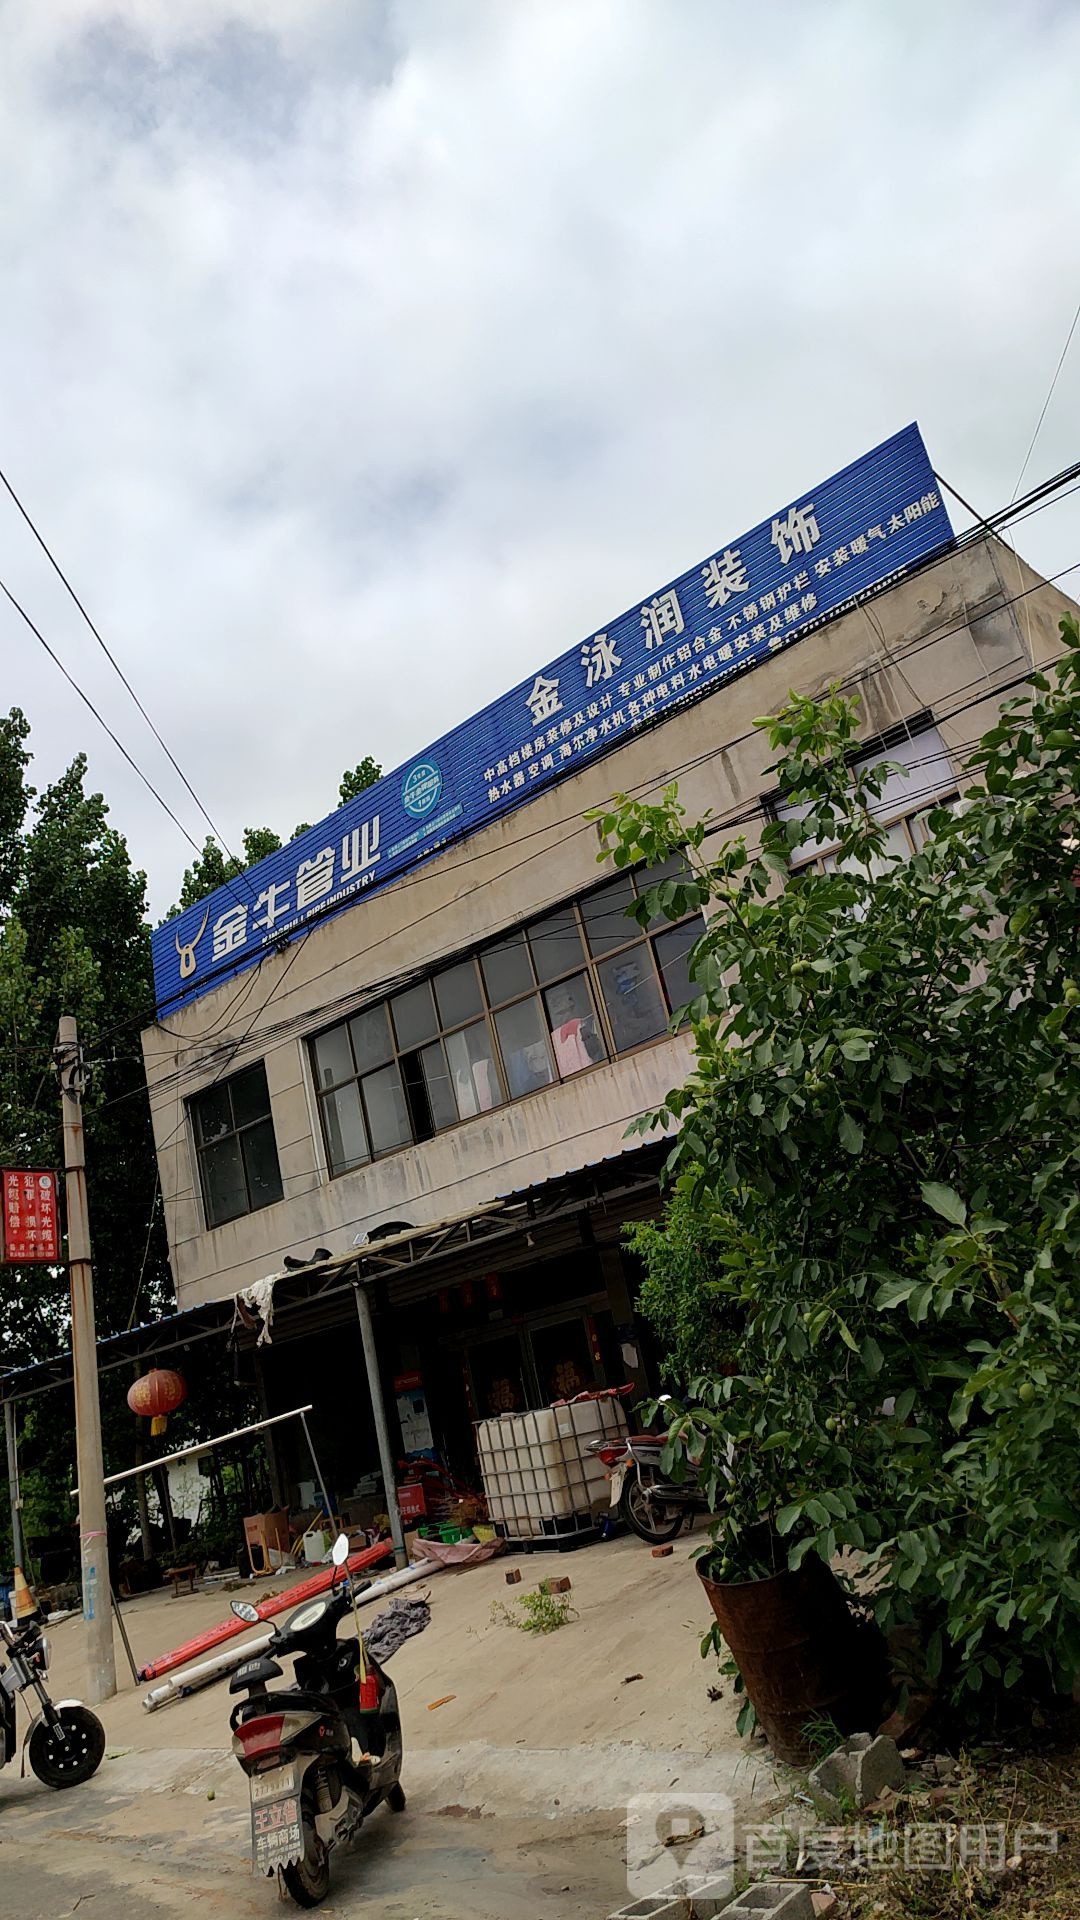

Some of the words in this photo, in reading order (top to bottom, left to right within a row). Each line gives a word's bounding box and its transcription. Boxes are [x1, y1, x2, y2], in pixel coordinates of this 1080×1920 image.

[484, 694, 613, 783] 中高档楼房装修及设计
[618, 627, 723, 699] 专业制作铝合金
[727, 572, 811, 631] 不锈钢护栏
[814, 523, 886, 578] 安装暖气
[887, 492, 940, 534] 太阳能
[488, 771, 526, 804] 热水器
[527, 752, 555, 780] 空调
[559, 710, 626, 760] 海尔净水机
[627, 672, 686, 718] 各种电料
[688, 592, 818, 680] 水电暖安装及维修
[525, 503, 820, 726] 金泳润装饰
[212, 814, 381, 962] 金牛管业
[39, 1189, 53, 1241] 破坏光缆
[256, 1823, 300, 1852] 车辆商场
